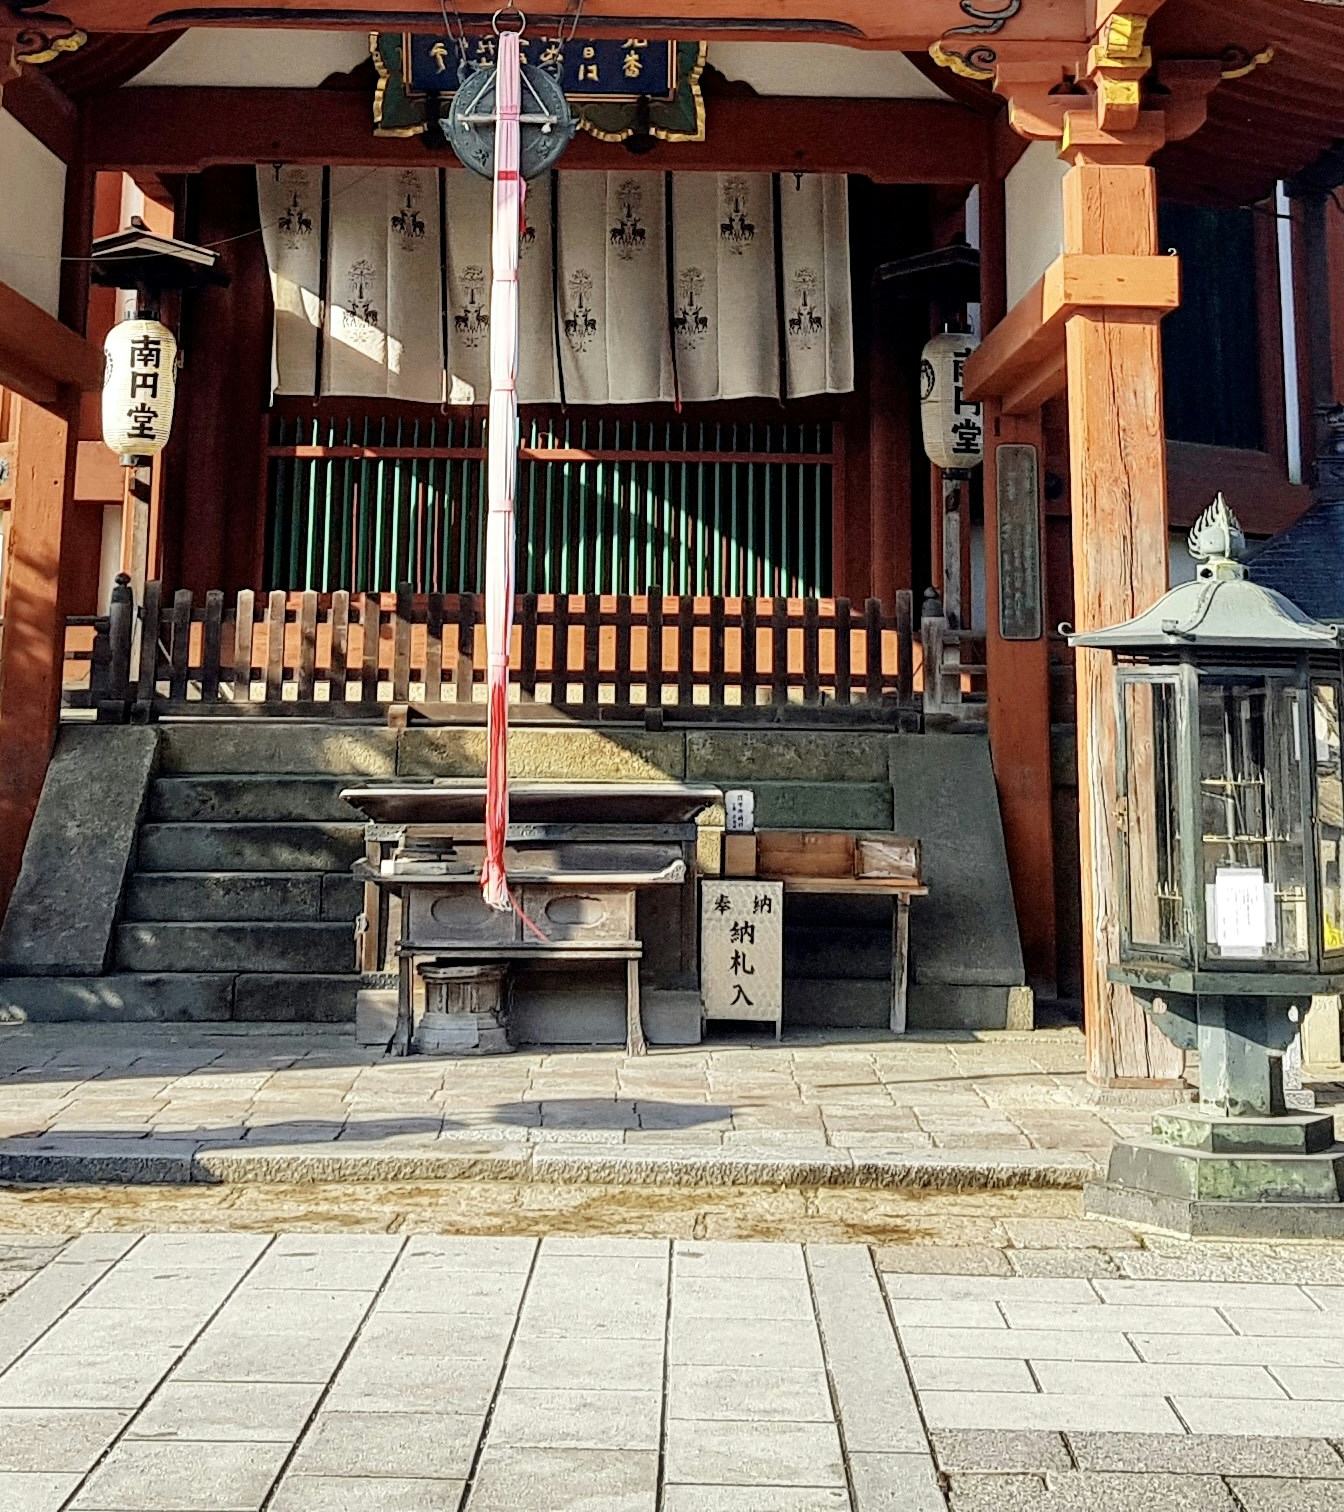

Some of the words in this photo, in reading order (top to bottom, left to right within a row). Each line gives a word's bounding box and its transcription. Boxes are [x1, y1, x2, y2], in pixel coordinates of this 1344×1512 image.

[126, 334, 162, 441] 南円堂
[728, 920, 755, 1006] 納札入
